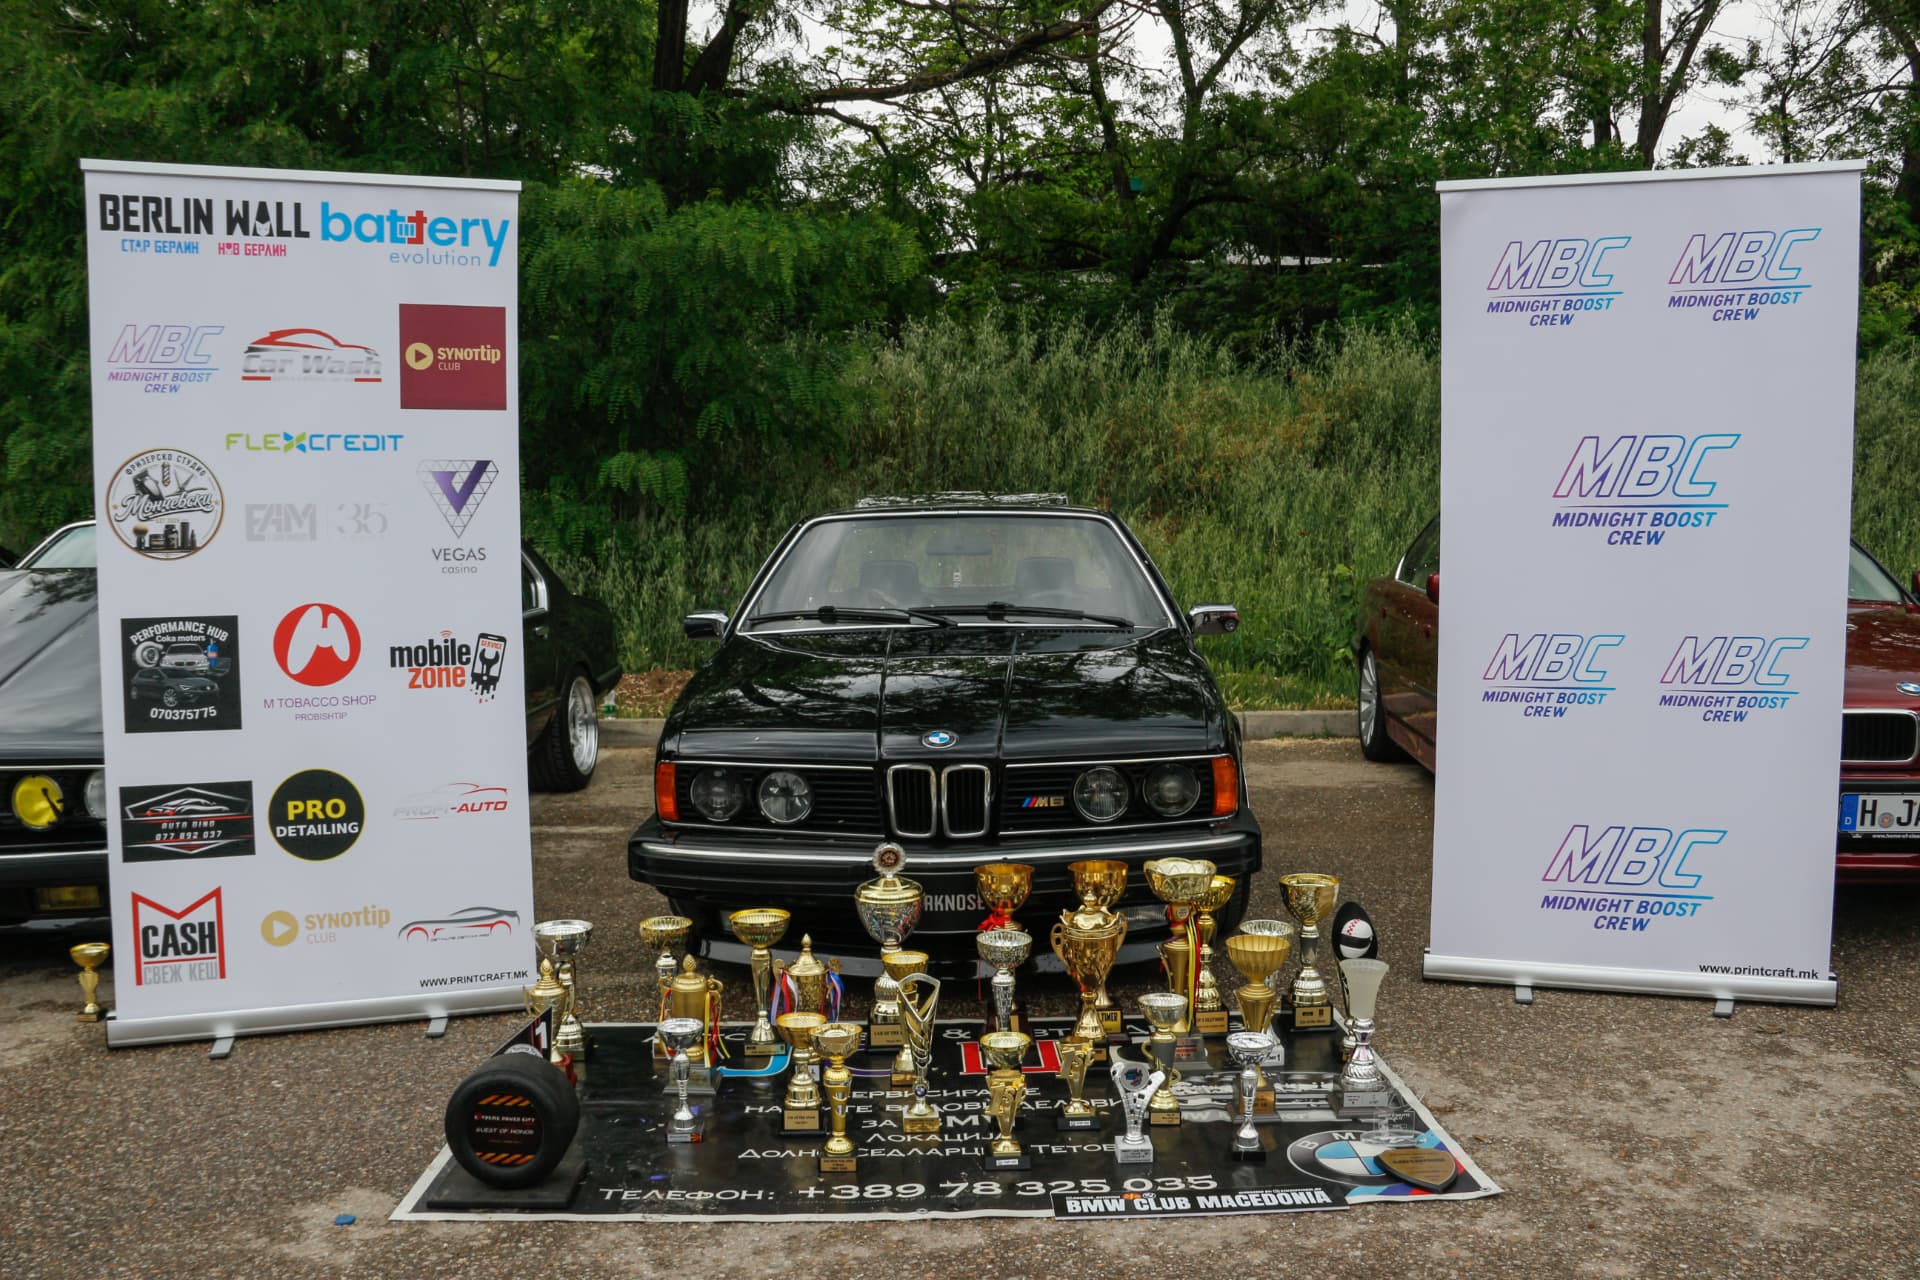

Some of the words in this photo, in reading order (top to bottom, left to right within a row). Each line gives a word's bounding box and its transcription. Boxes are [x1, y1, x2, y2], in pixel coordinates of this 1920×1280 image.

[99, 193, 213, 235] BERLIN
[226, 199, 311, 238] WALL
[321, 201, 510, 267] battery
[121, 239, 150, 253] СТАР
[154, 240, 199, 255] БЕРЛИН
[245, 243, 287, 257] БЕРЛИН
[389, 248, 481, 267] evolution
[1487, 235, 1632, 290] MBC
[1668, 227, 1822, 285] MBC
[1486, 299, 1561, 313] MIDNIGHT
[1563, 297, 1615, 311] BOOST
[1668, 293, 1744, 308] MIDNIGHT
[1747, 291, 1803, 306] BOOST
[1529, 313, 1574, 327] CREW
[1712, 308, 1759, 322] CREW
[107, 324, 225, 364] MBC
[438, 362, 461, 371] CLUB
[108, 371, 169, 382] MIDNIGHT
[171, 372, 212, 382] BOOST
[144, 383, 181, 393] CREW
[1552, 433, 1742, 499] MBC
[1552, 511, 1648, 528] MIDNIGHT
[1649, 511, 1718, 528] BOOST
[1606, 530, 1665, 546] CREW
[431, 547, 487, 562] VEGAS
[441, 565, 478, 574] casino
[129, 620, 207, 646] PERFORMANCE
[206, 625, 229, 642] HUB
[155, 635, 177, 643] Coka
[390, 638, 472, 668] mobile
[1482, 633, 1626, 683] MBC
[1659, 635, 1810, 686] MBC
[407, 666, 466, 689] zone
[263, 698, 274, 709] M
[276, 696, 339, 709] TOBACCO
[342, 694, 377, 706] SHOP
[1481, 690, 1554, 704] MIDNIGHT
[1556, 691, 1608, 706] BOOST
[1658, 694, 1735, 708] MIDNIGHT
[1737, 695, 1790, 710] BOOST
[149, 706, 217, 720] 070375775
[295, 712, 348, 721] PROBISHTIP
[1523, 705, 1568, 718] CREW
[1702, 709, 1748, 722] CREW
[287, 798, 347, 821] PRO
[1844, 816, 1852, 825] D
[1860, 799, 1878, 827] H
[275, 821, 360, 838] DETAILING
[1541, 824, 1728, 889] MBC
[1540, 895, 1634, 913] MIDNIGHT
[1635, 899, 1703, 917] BOOST
[1593, 915, 1651, 932] CREW
[142, 921, 217, 958] CASH
[306, 932, 337, 944] CLUB
[143, 964, 183, 985] СВЕЖ
[189, 961, 218, 982] КЕШ
[420, 970, 528, 988] WWW.PRINTCRAFT.MK
[1698, 964, 1819, 979] www.printcraft.mk
[535, 1021, 548, 1049] 1
[738, 1148, 820, 1158] ДОЛН
[857, 1147, 985, 1157] СЕДЛАРЦ
[1030, 1143, 1116, 1154] ТЕТОВ
[599, 1188, 775, 1200] ТЕЛЕФОН:
[798, 1183, 926, 1199] +389
[939, 1180, 1003, 1198] 78
[1016, 1178, 1111, 1197] 325
[1123, 1175, 1218, 1193] 035
[1066, 1198, 1126, 1213] BMW
[1134, 1196, 1192, 1211] CLUB
[1197, 1190, 1333, 1209] MACEDONIA
